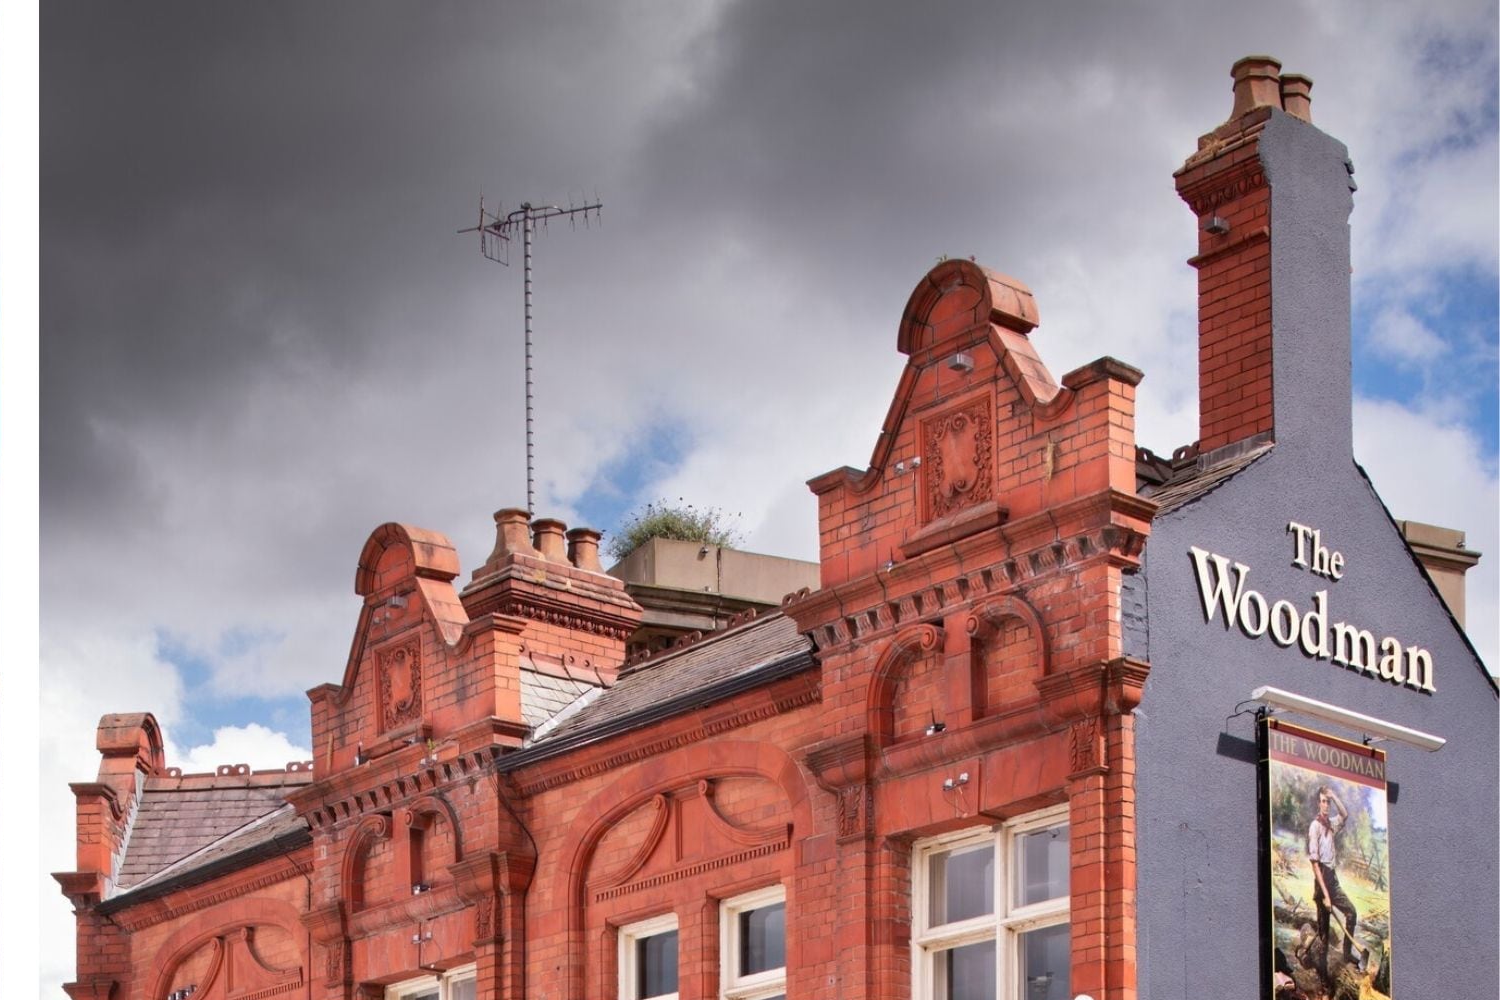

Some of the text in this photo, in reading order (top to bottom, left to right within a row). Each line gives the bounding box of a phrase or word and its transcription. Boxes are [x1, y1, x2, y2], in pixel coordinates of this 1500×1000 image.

[1287, 521, 1345, 580] The
[1190, 545, 1438, 693] Woodman
[1270, 732, 1385, 779] THE WOODMAN
